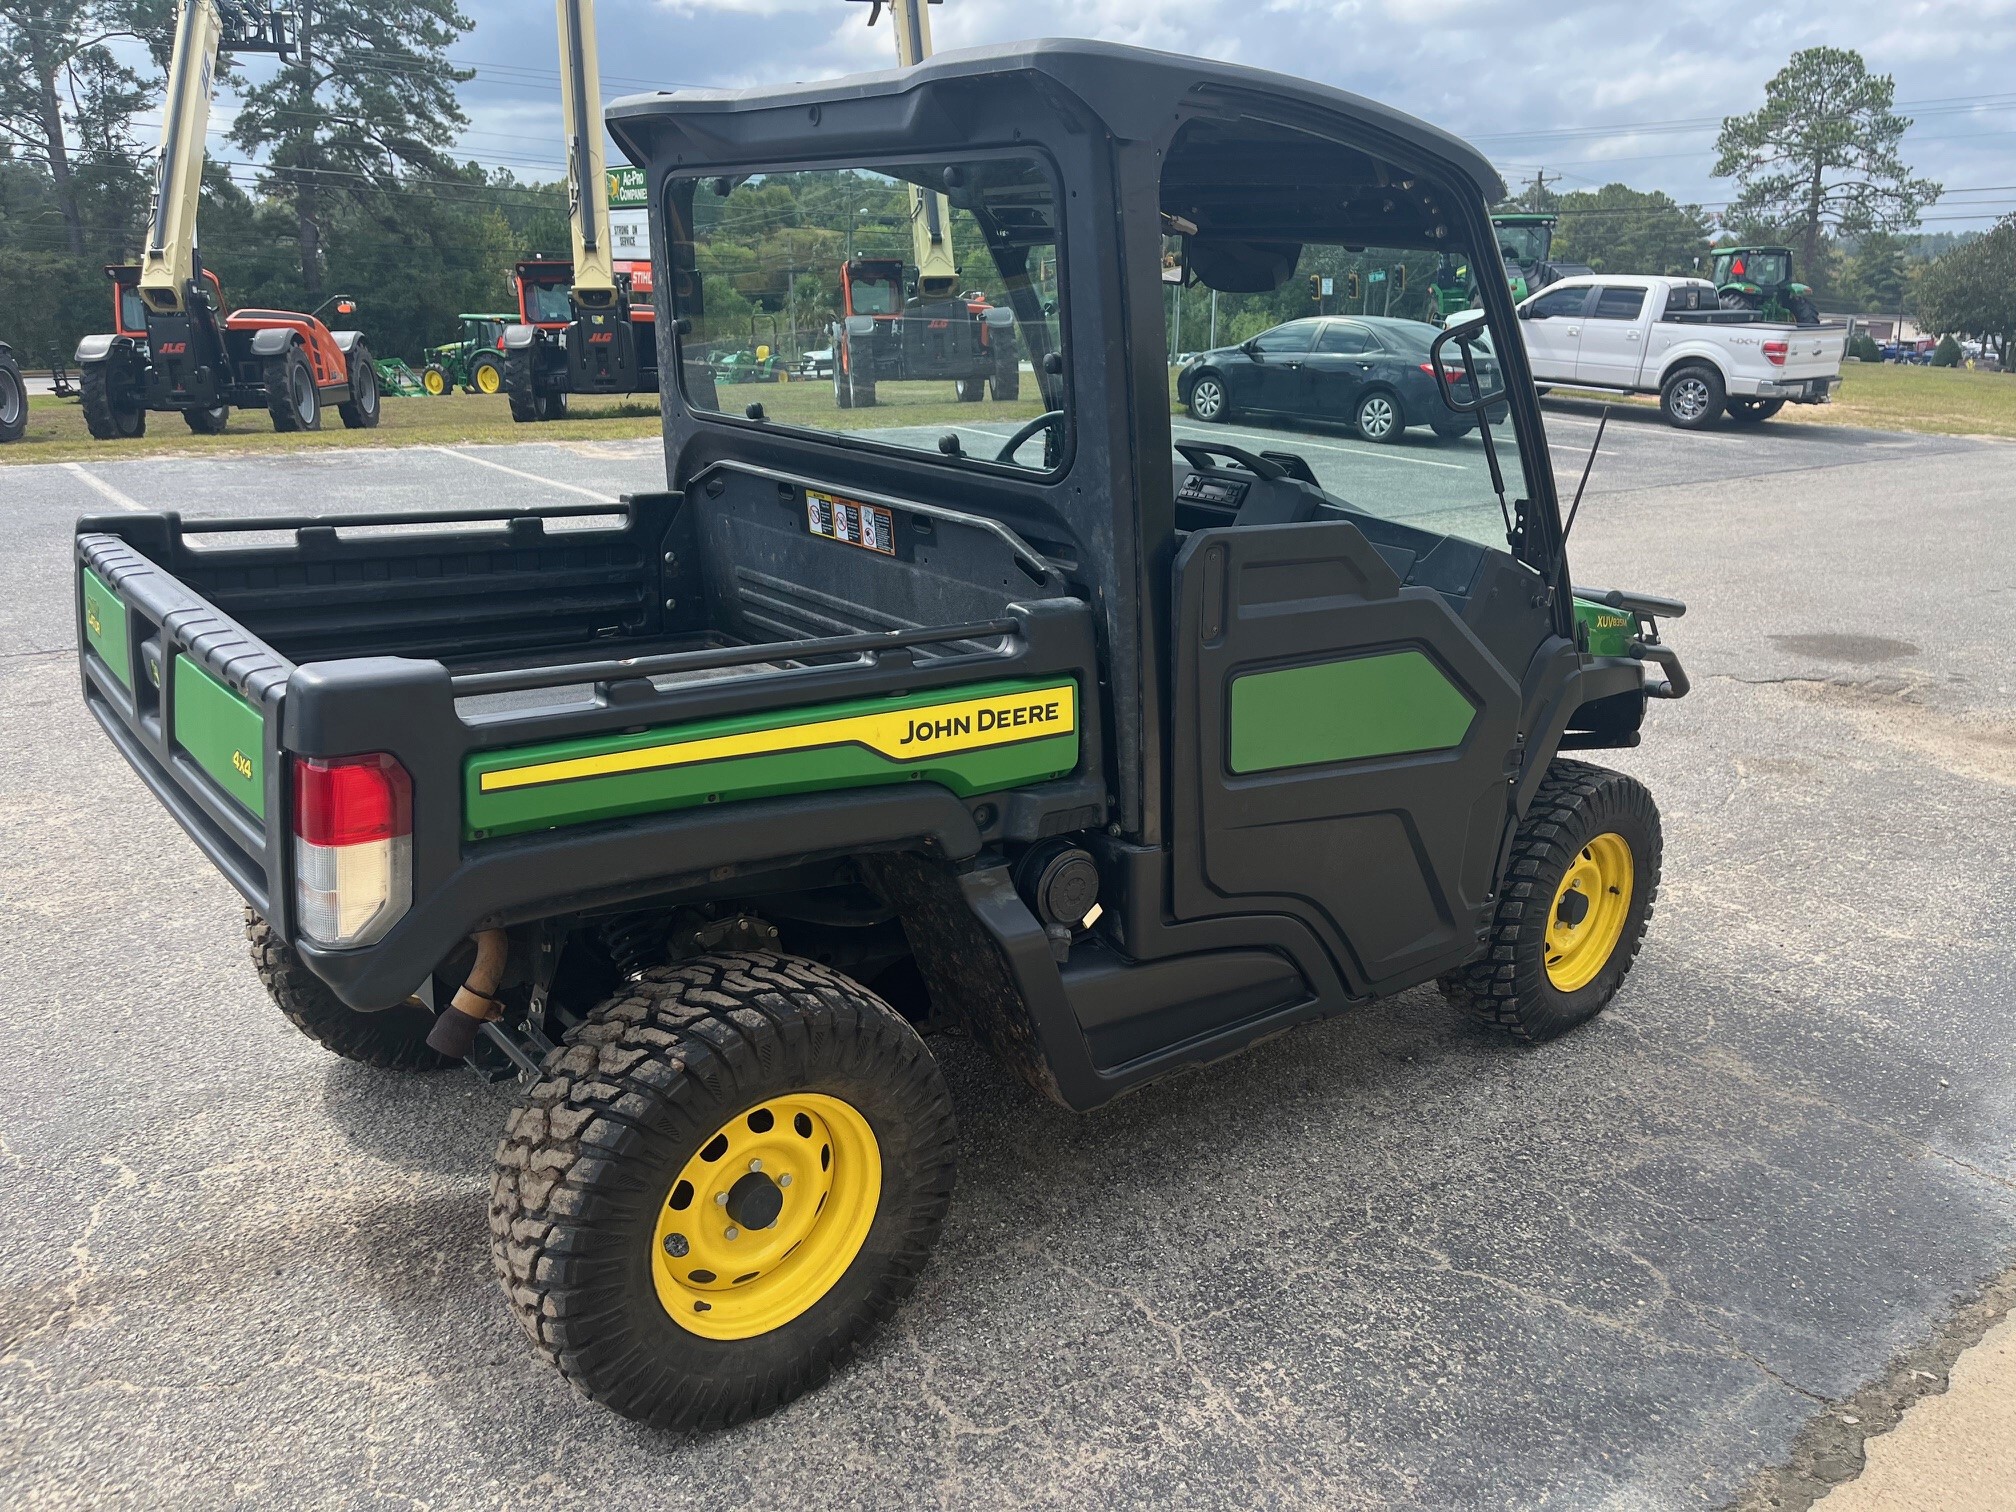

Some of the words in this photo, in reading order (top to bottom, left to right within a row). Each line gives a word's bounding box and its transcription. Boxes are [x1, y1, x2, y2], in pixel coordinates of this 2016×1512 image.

[622, 170, 644, 186] AG-PRO
[613, 225, 629, 236] STRONG
[631, 225, 638, 235] ON
[619, 237, 636, 247] SERVICE
[632, 270, 652, 285] STIHL
[588, 332, 613, 343] JLG
[158, 342, 187, 354] JLG
[900, 715, 971, 745] JOHN
[977, 702, 1059, 732] DEERE
